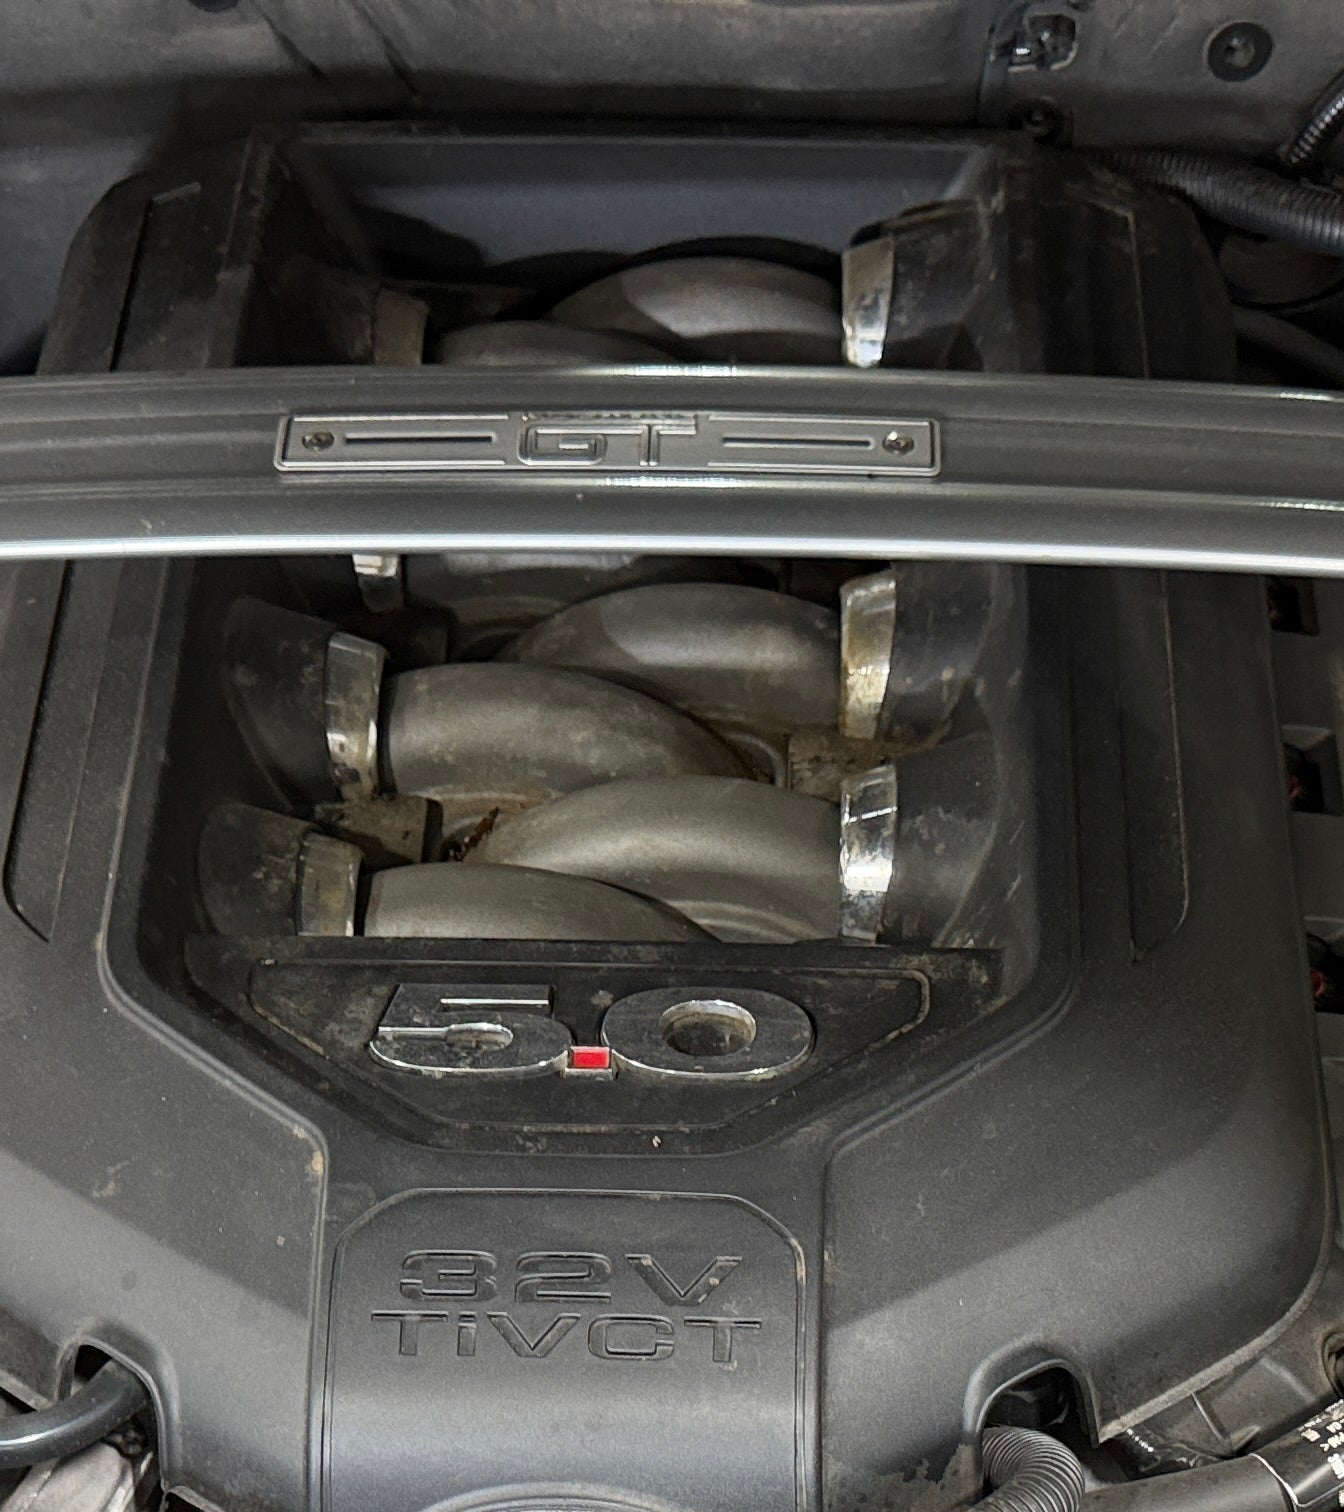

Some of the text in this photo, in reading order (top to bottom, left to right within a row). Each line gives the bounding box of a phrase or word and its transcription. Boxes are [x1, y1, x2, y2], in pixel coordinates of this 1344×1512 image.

[517, 414, 697, 467] GT
[369, 984, 816, 1078] 5.0
[400, 1249, 743, 1306] 32V
